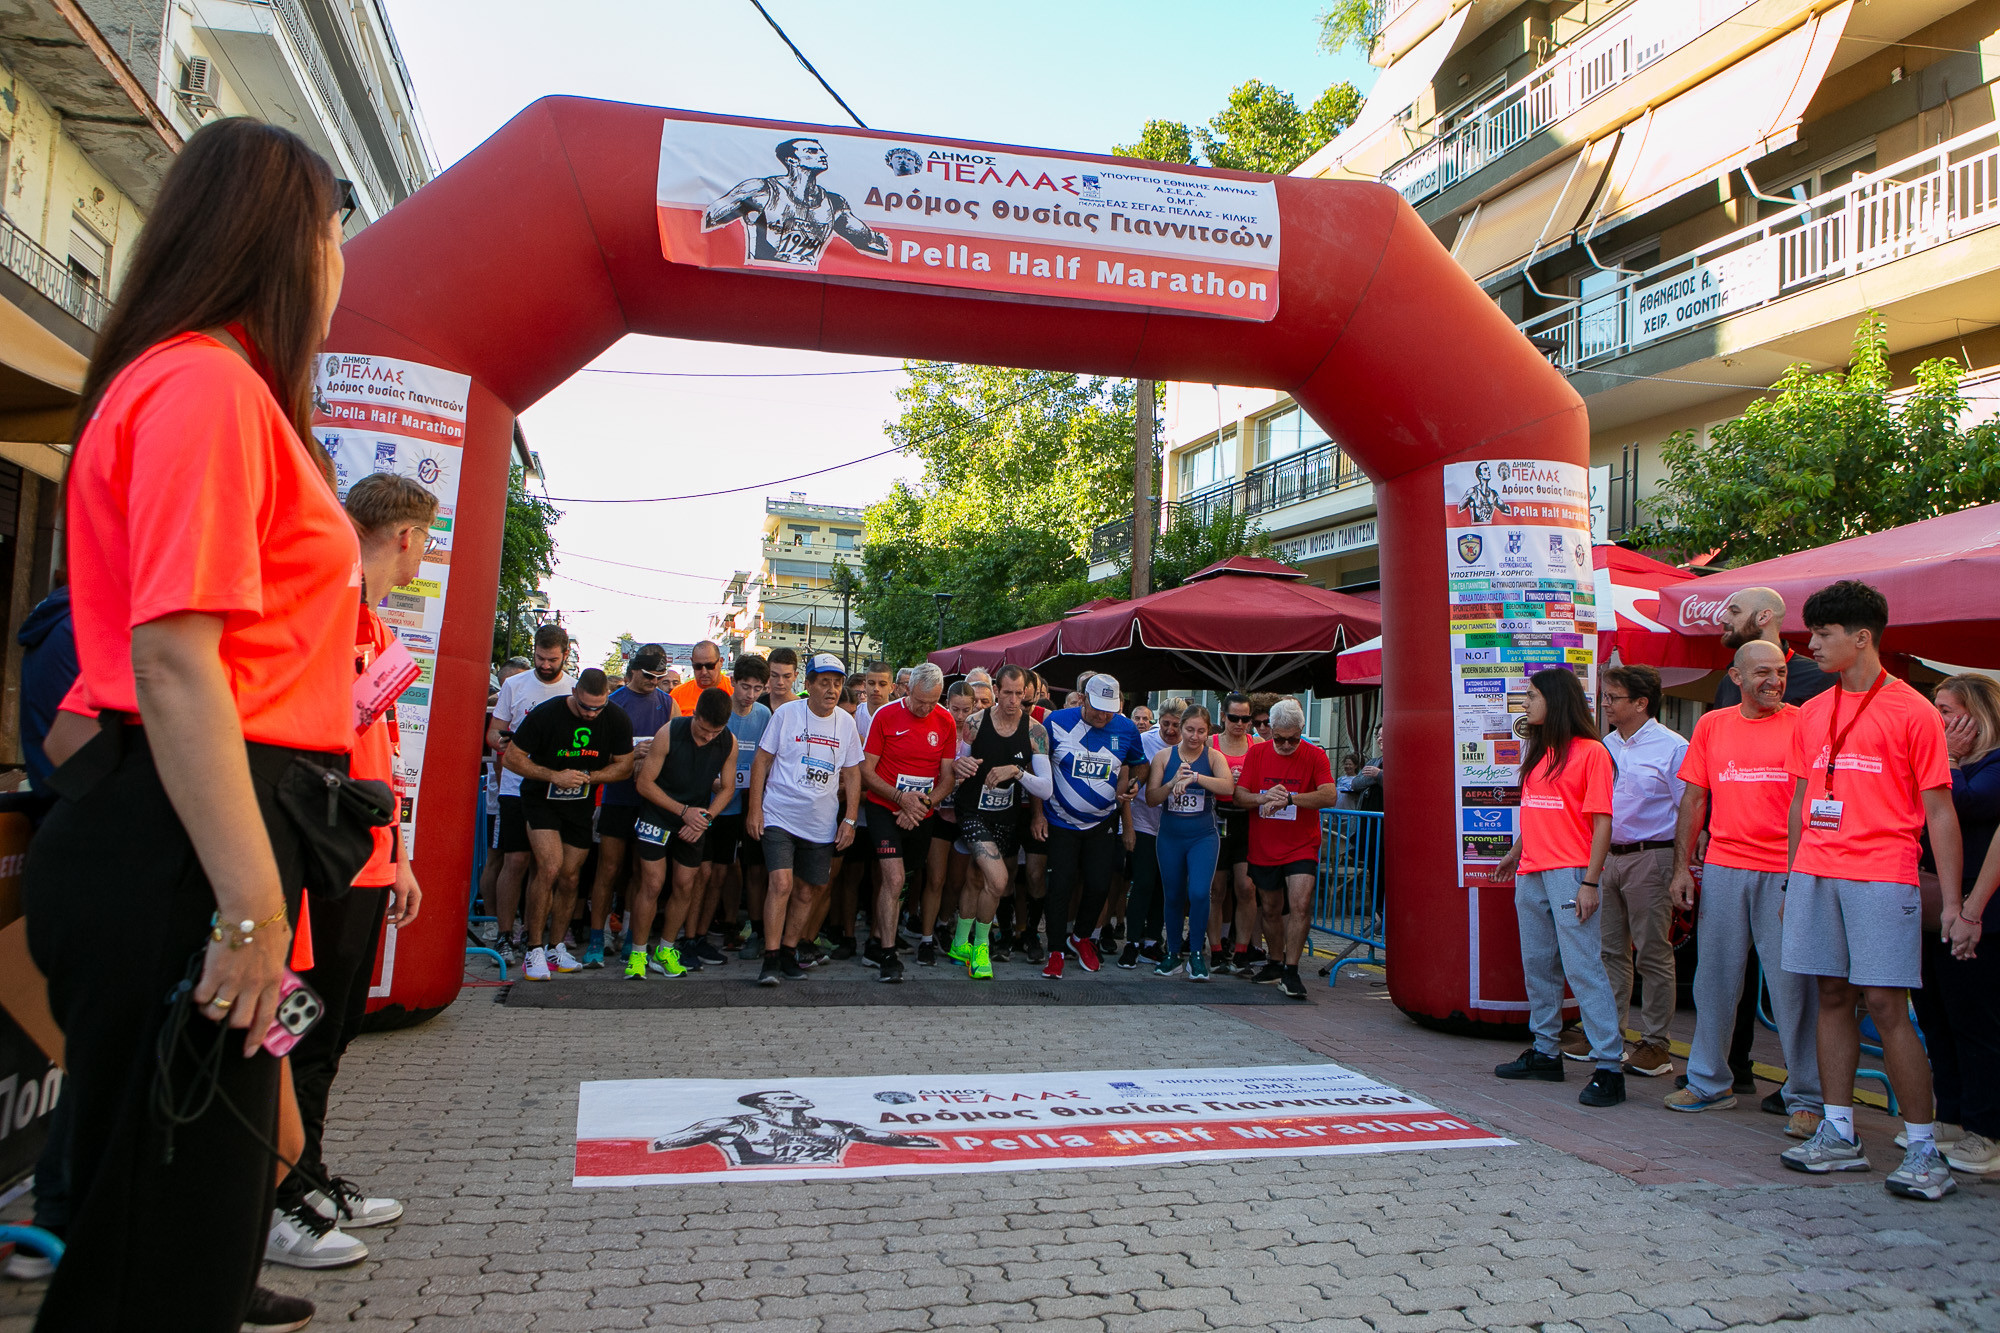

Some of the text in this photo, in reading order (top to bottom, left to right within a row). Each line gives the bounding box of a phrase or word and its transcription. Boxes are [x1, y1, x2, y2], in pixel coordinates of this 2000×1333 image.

[928, 151, 996, 166] ΔΗΜΟΣ
[927, 160, 1080, 196] ΠΕΛΛΑΣ
[1100, 172, 1258, 196] ΥΠΟΥΡΓΕΙΟ ΕΘΝΙΚΗΣ ΑΜΥΝΑΣ
[1156, 187, 1206, 198] Α.Σ.Ε.Α.Δ.
[1166, 197, 1198, 206] Ο.Μ.Γ.
[864, 187, 1273, 249] Δρόμος θυσίας Γιαννιτσών
[1106, 200, 1128, 209] ΕΑΣ
[1131, 202, 1165, 214] ΣΕΓΑΣ
[1168, 207, 1212, 219] ΠΕΛΛΑΣ
[1222, 213, 1258, 224] ΚΙΛΚΙΣ
[900, 240, 1267, 301] Pella Half Marathon
[1640, 276, 1695, 315] ΑΘΑΝΑΣΙΟΣ
[1643, 313, 1670, 335] ΧΕΙΡ.
[343, 355, 371, 365] ΔΗΜΟΣ
[340, 364, 404, 385] ΠΕΛΛΑΣ
[327, 381, 464, 413] Δρόμος θυσίας Γιαννιτσών
[335, 405, 462, 438] Pella Half Marathon
[1512, 468, 1559, 483] ΠΕΛΛΑΣ
[1502, 484, 1533, 495] Δρόμος
[1537, 485, 1562, 496] θυσίας
[1513, 506, 1538, 517] Pella
[1542, 507, 1559, 518] Half
[1310, 532, 1334, 553] ΜΟΥΣΕΙΟ
[1339, 522, 1375, 547] ΓΙΑΝΝΙΤΣΩΝ
[1450, 570, 1495, 579] ΥΠΟΣΤΗΡΙΞΗ
[1679, 592, 1738, 627] Coca-C
[1501, 622, 1531, 630] Φ.Ο.Ο.Γ.
[1465, 652, 1490, 660] Ν.Ο.Γ
[1493, 665, 1509, 673] SCHOOL
[807, 768, 828, 784] 569
[1079, 761, 1104, 775] 307
[1174, 795, 1197, 808] 483
[920, 1090, 1091, 1104] ΠΕΛΛΑΣ
[880, 1094, 1413, 1125] Δρόμος θυσίας Γιαννιτσών
[953, 1119, 1471, 1151] Pella Half Marathon
